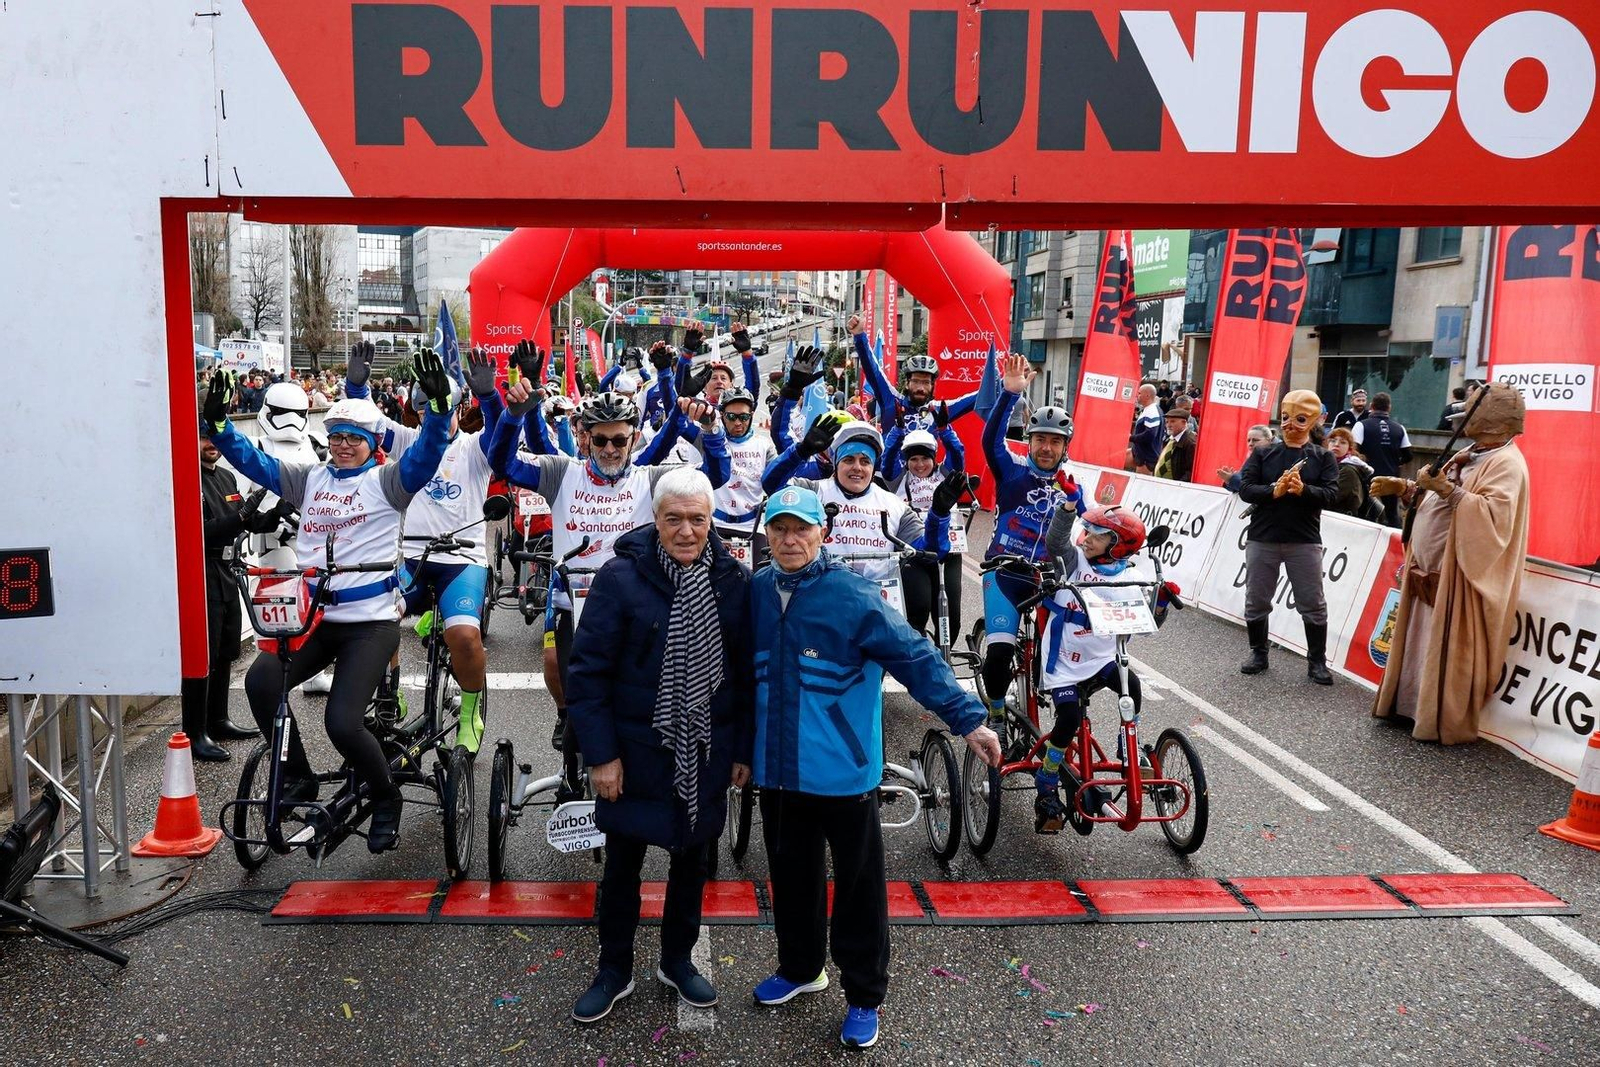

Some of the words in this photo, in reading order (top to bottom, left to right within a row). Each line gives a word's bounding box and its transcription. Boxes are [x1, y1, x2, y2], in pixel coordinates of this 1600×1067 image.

[697, 242, 783, 252] sportssantander.es
[486, 324, 522, 337] Sports
[958, 329, 994, 342] Sports
[1216, 378, 1258, 391] CONCELLO
[1498, 374, 1586, 386] CONCELLO
[1218, 388, 1226, 398] DE
[1228, 390, 1250, 400] VIGO
[1532, 388, 1574, 400] VIGO
[526, 496, 544, 506] 630
[570, 505, 612, 516] CALVARIO
[313, 514, 368, 532] Santander
[579, 522, 635, 532] Santander
[835, 534, 888, 548] Santander
[262, 606, 287, 622] 611
[1102, 608, 1136, 620] 554
[564, 840, 591, 851] VIGO
